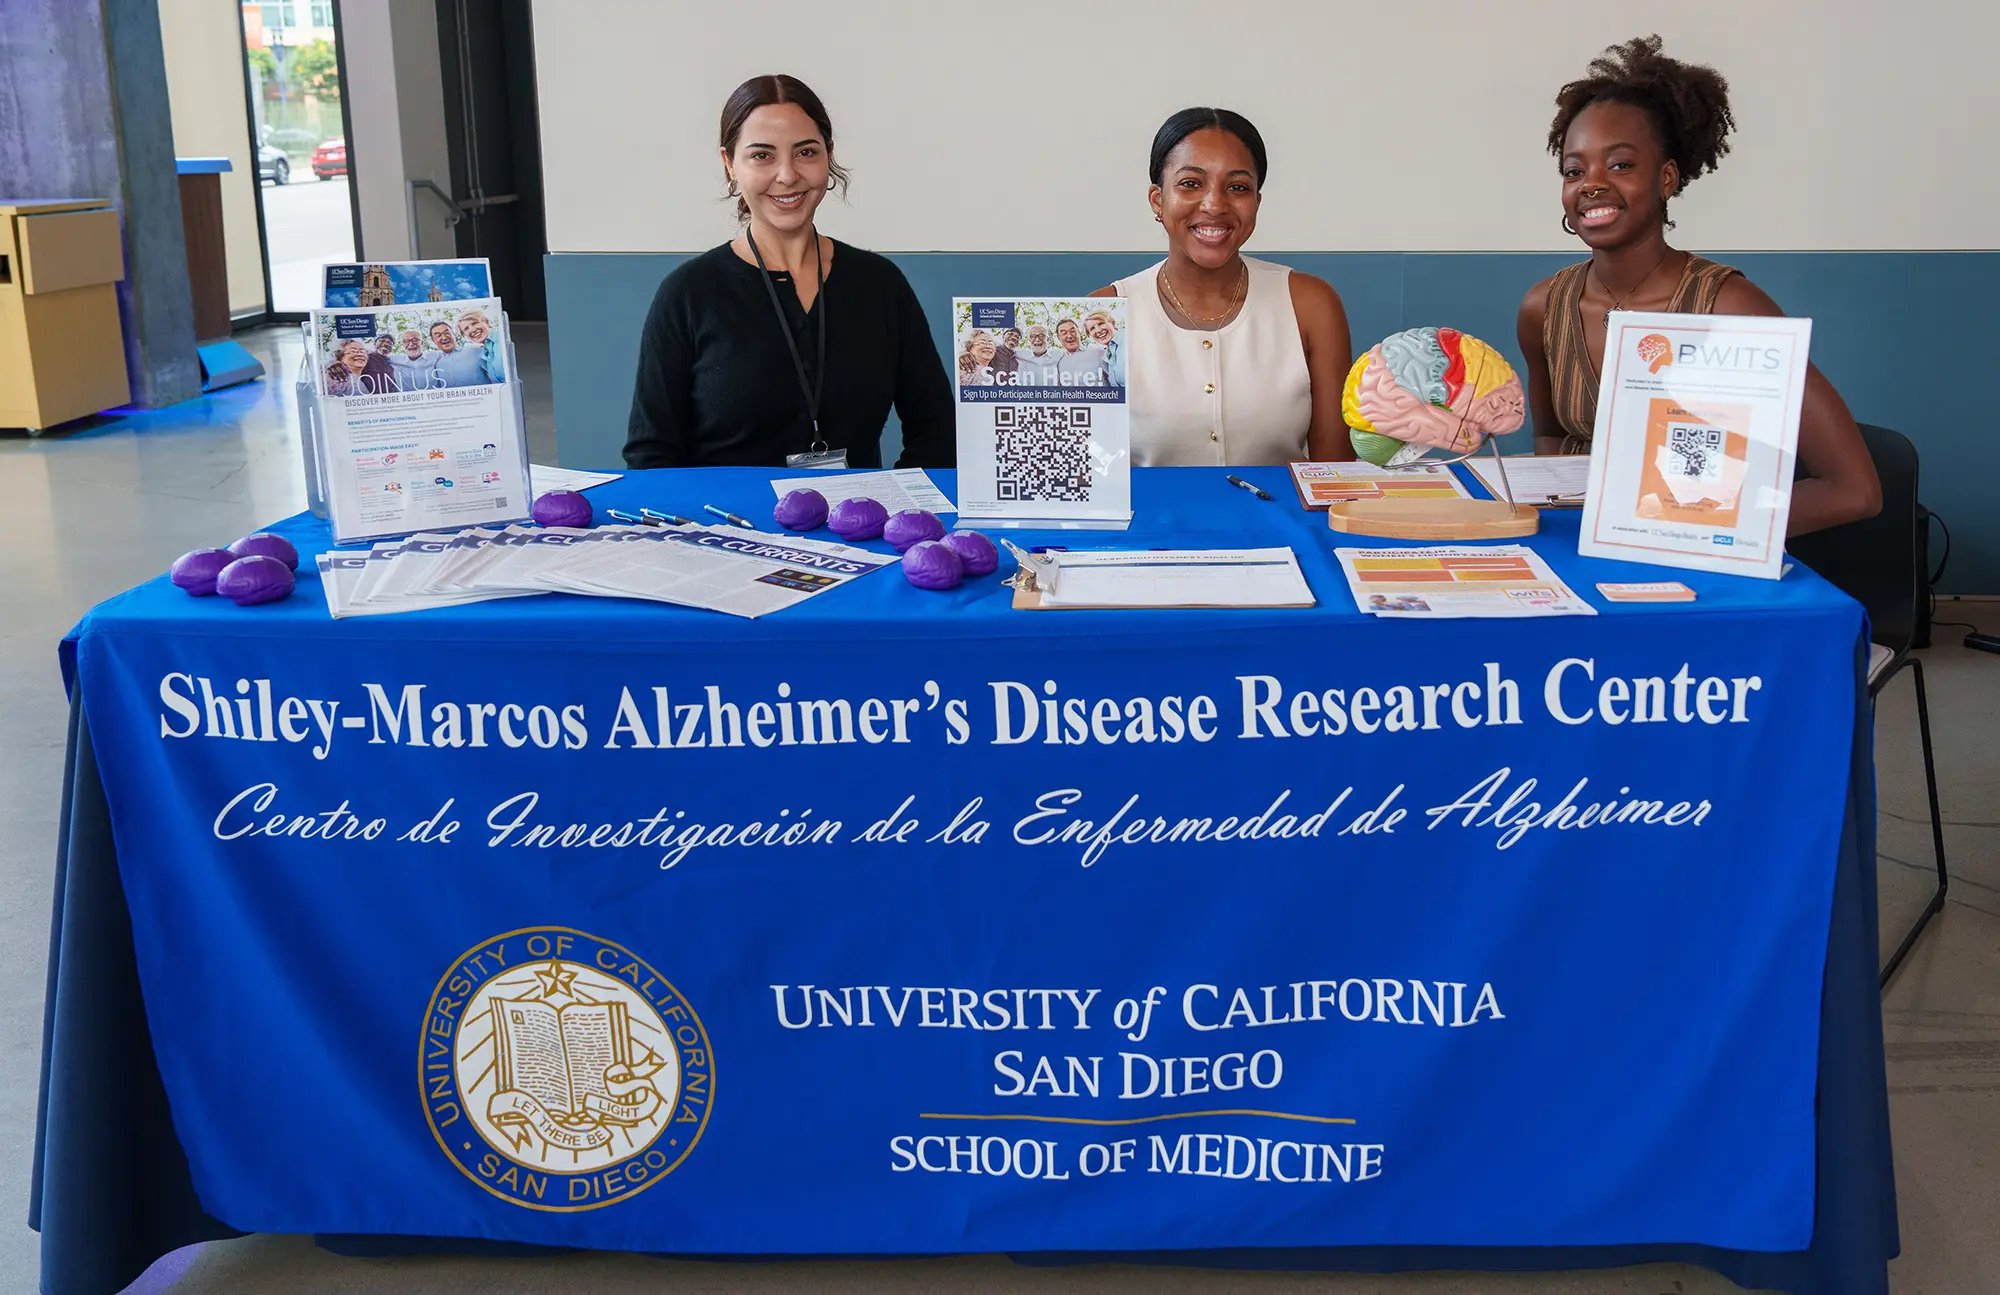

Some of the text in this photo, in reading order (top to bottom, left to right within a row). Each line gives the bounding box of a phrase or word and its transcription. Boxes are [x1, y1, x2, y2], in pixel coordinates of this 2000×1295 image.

[981, 366, 1103, 386] Scan Here!
[1678, 344, 1780, 370] BWITS
[343, 368, 447, 397] JOIN US
[345, 388, 492, 407] DISCOVER MORE ABOUT YOUR BRAIN HEALTH
[964, 389, 1118, 400] Sign Up to Participate in Brain Health Research!
[722, 540, 865, 572] CURRENTS
[1714, 536, 1732, 544] UCLA
[160, 658, 1761, 759] Shiley-Marcos Alzheimer's Disease Research Center
[214, 767, 1711, 869] Centro de Investigación de la Enfermedad de Alzheimer
[428, 935, 709, 1128] UNIVERSITY OF CALIFORNIA
[770, 979, 1505, 1040] UNIVERSITY of CALIFORNIA
[995, 1049, 1284, 1098] SAN DIEGO
[512, 1096, 640, 1146] LET THERE BE LIGHT
[478, 1150, 666, 1202] SAN DIEGO
[891, 1134, 1384, 1182] SCHOOL OF MEDICINE
